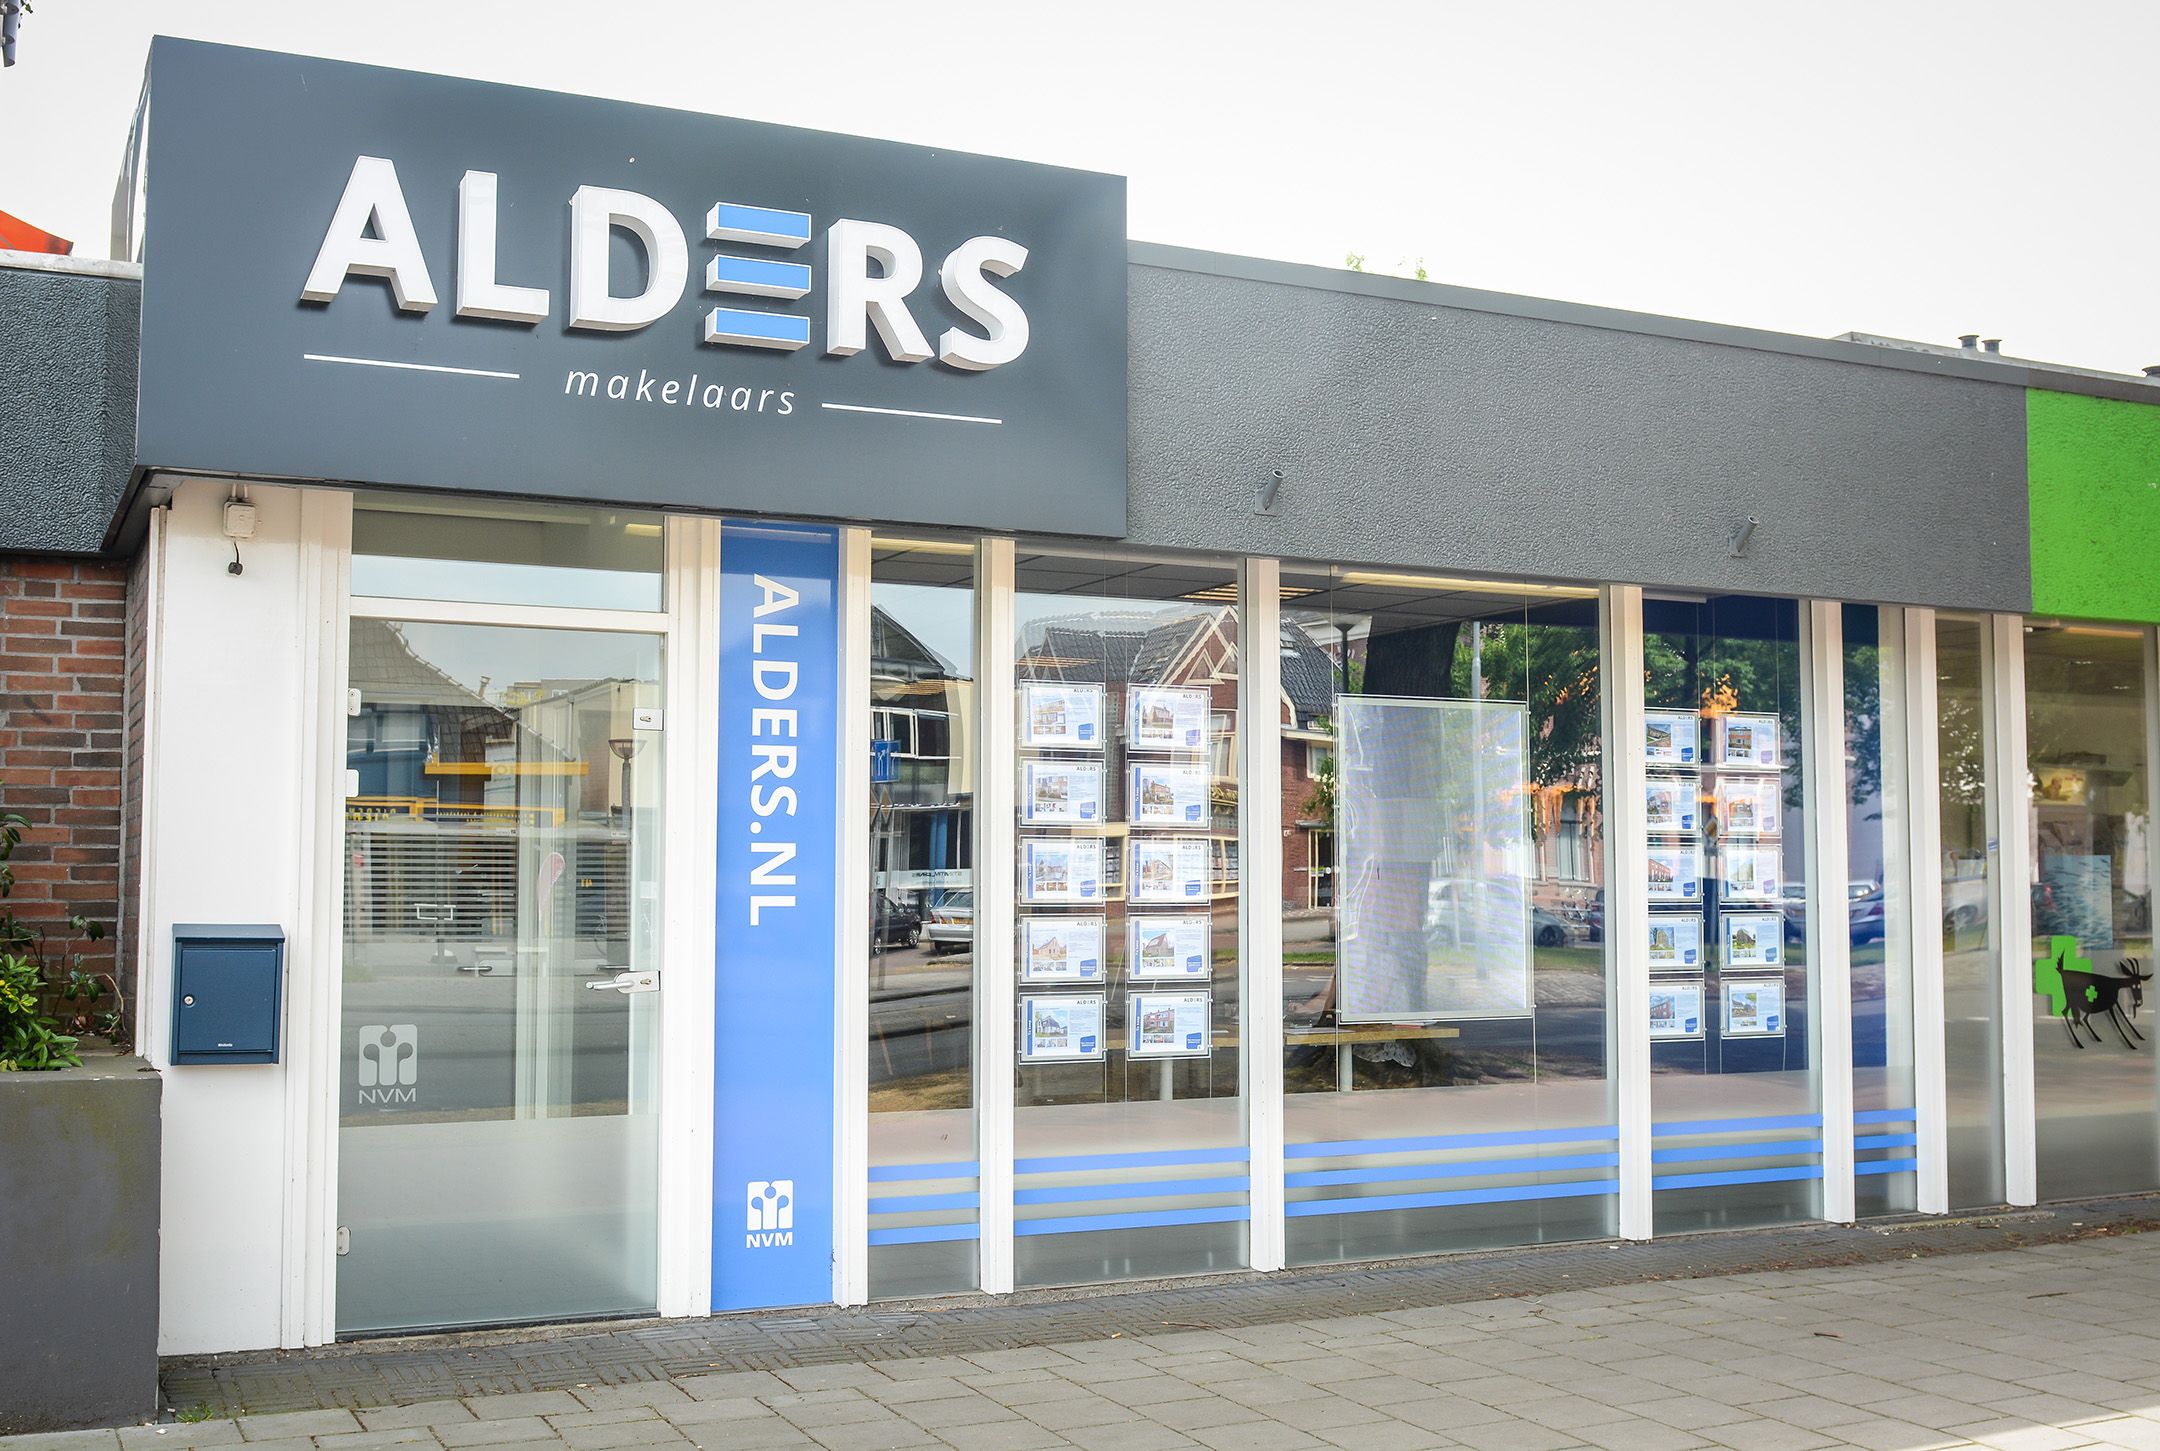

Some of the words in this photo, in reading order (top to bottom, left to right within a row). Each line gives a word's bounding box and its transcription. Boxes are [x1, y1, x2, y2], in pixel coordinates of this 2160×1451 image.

[300, 154, 1031, 372] ALDERS
[564, 369, 796, 416] makelaars
[749, 573, 800, 927] ALDERS.NL
[358, 1087, 417, 1104] NVM
[745, 1231, 793, 1249] NVM
